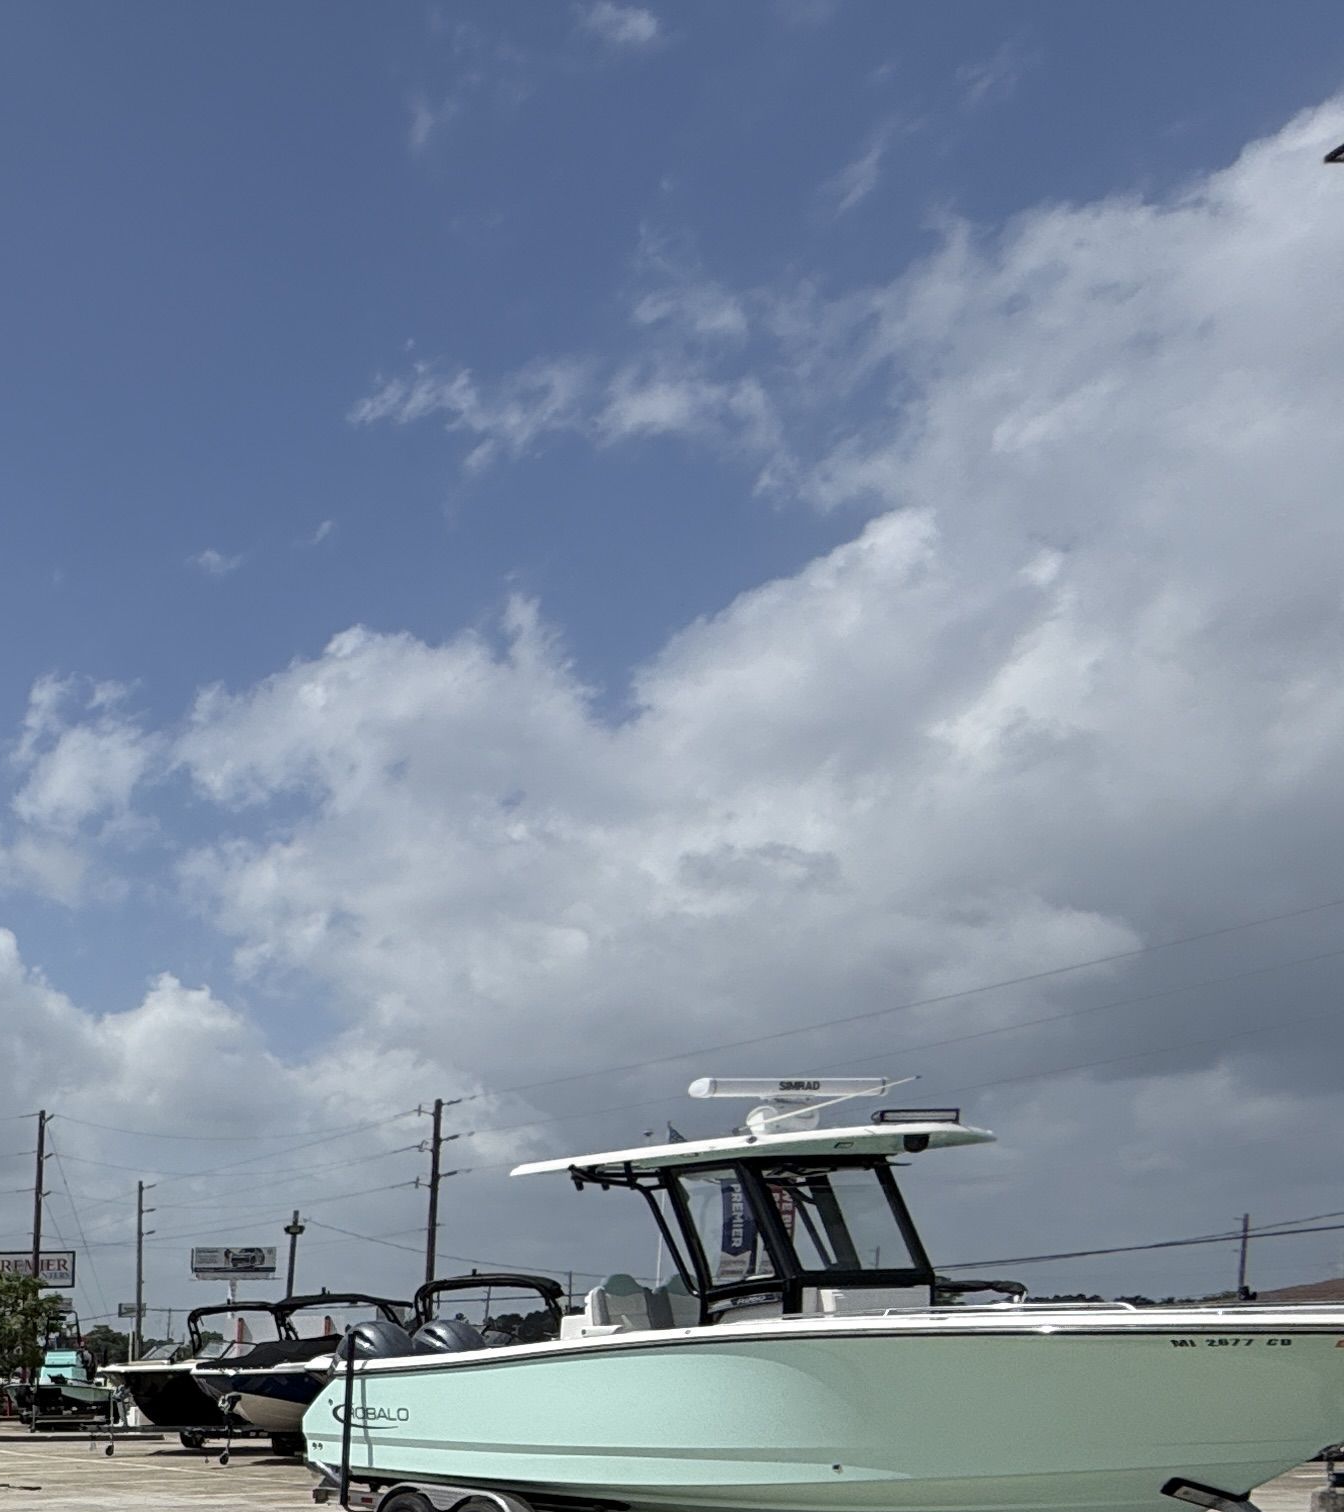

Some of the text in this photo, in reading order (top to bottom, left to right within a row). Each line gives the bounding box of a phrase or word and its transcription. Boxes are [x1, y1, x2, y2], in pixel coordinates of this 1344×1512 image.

[779, 1081, 820, 1090] SIMRAD
[731, 1184, 743, 1248] PREMIER
[1170, 1339, 1197, 1347] MI
[351, 1406, 409, 1421] OBALO
